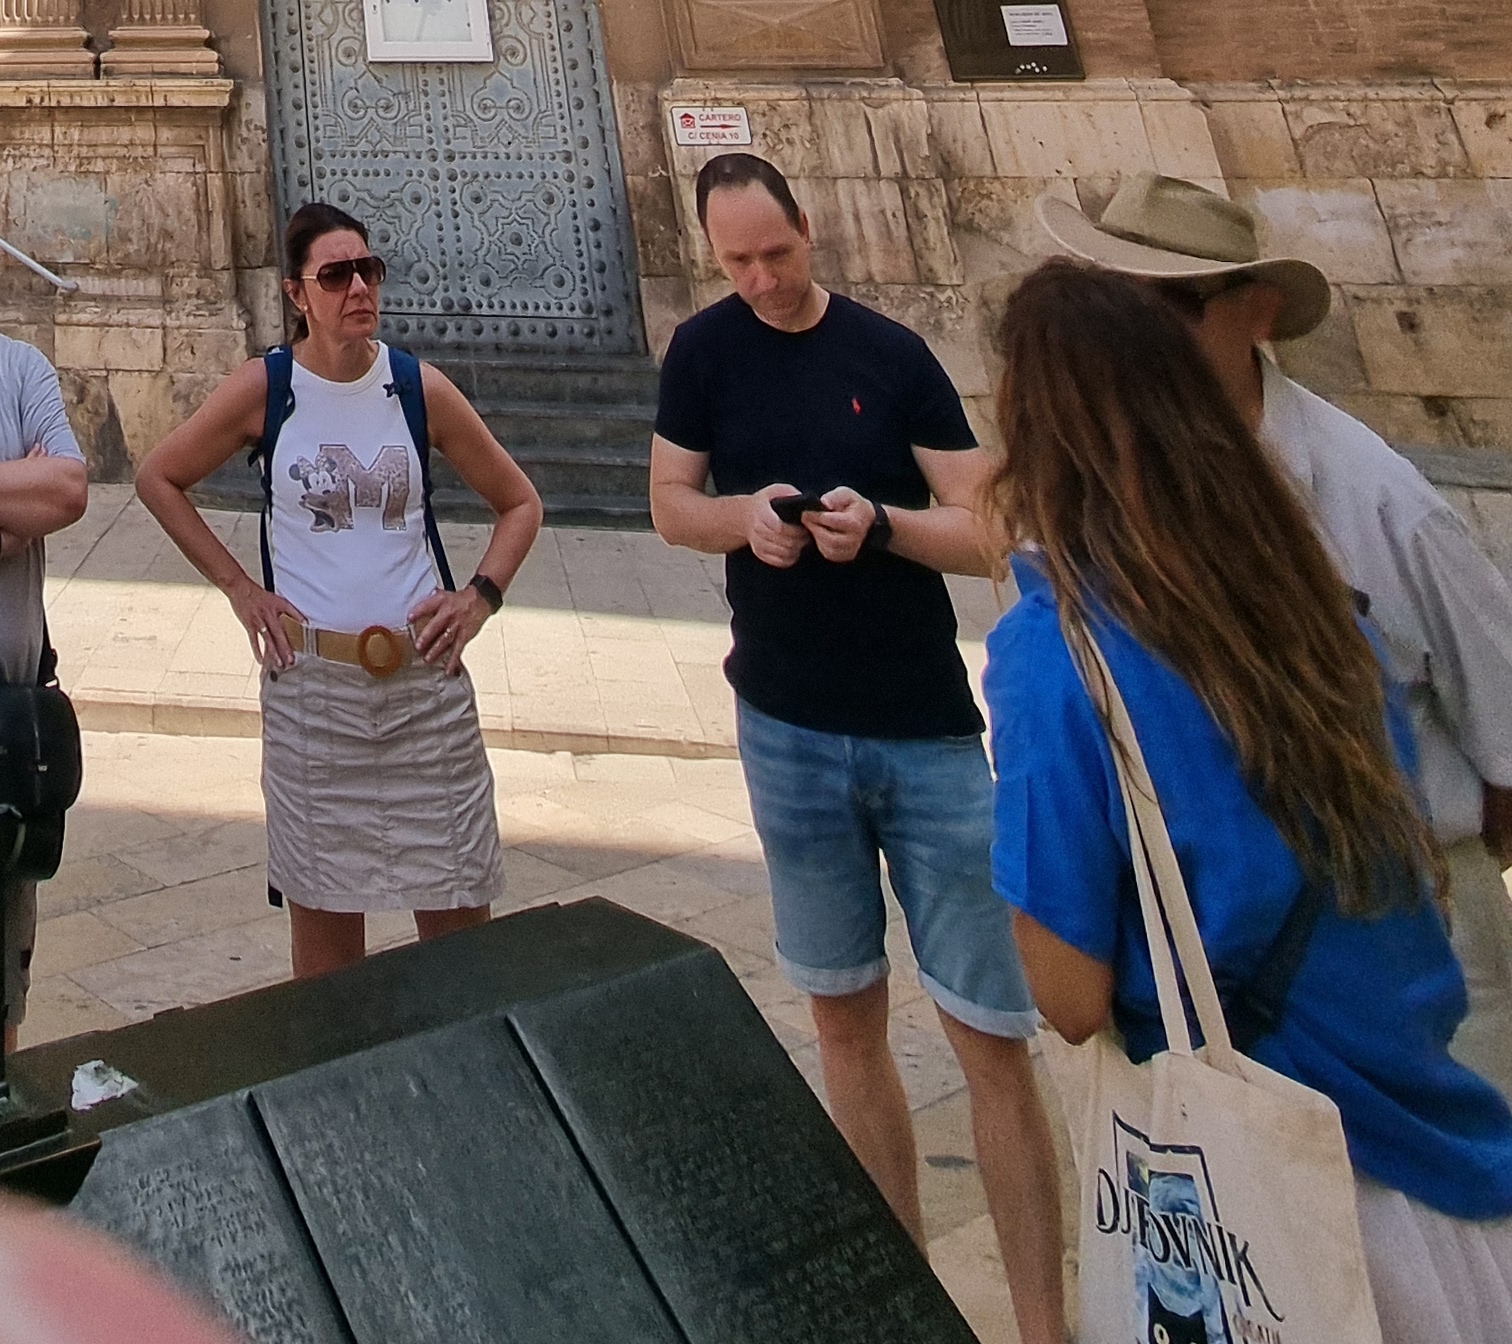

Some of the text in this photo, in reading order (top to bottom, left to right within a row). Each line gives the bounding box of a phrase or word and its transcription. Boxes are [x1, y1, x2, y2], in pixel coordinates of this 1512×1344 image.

[698, 113, 742, 122] CARTERO
[699, 132, 727, 140] CENIA
[729, 132, 740, 140] 10
